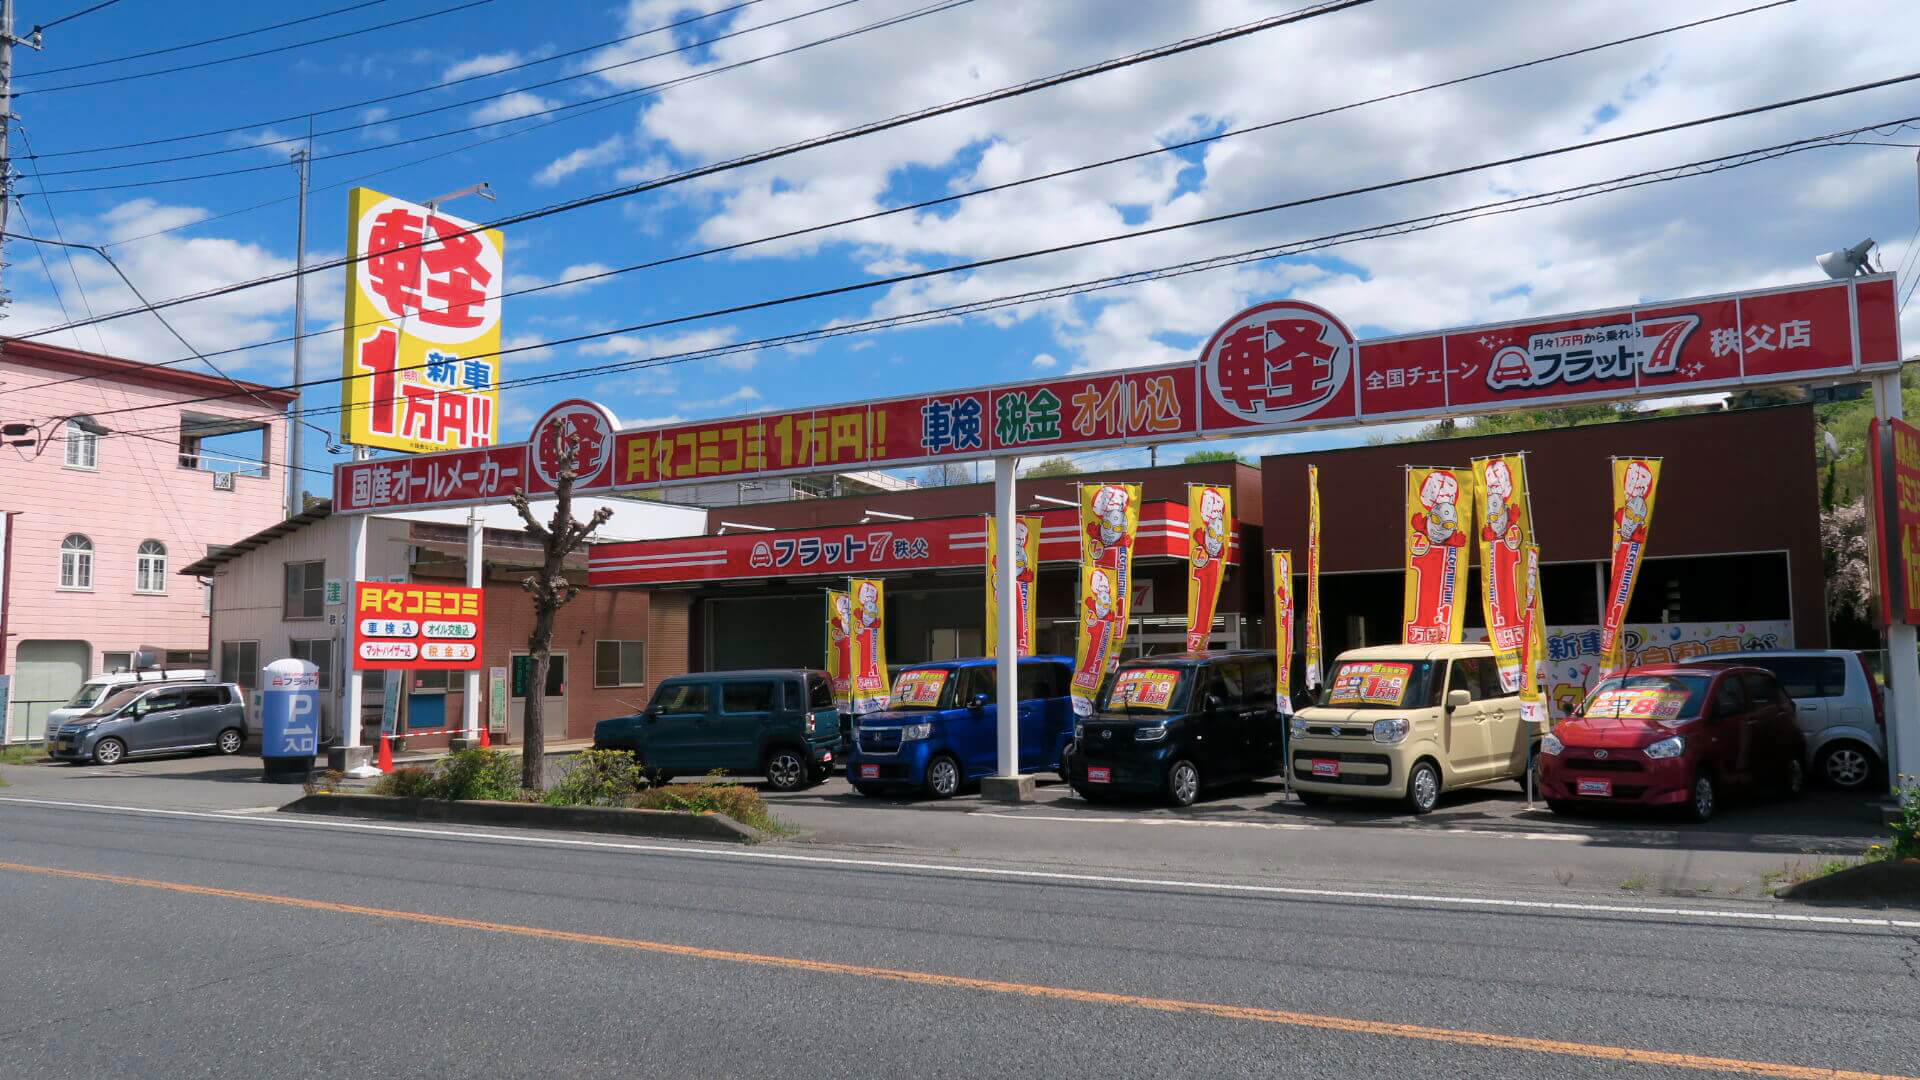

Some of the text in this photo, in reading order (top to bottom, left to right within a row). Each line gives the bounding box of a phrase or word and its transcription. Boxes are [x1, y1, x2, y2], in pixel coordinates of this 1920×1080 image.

[368, 208, 492, 329] 軽
[1710, 319, 1811, 358] 秩父店
[427, 352, 490, 390] 新車
[1217, 318, 1339, 414] 軽
[1365, 361, 1480, 391] 全国チェーン
[921, 375, 1181, 452] 車検 税金 オイル込
[352, 455, 519, 507] 国産オールメーカー
[894, 538, 929, 560] 秩父
[360, 587, 478, 617] 月々コミコミ
[367, 621, 413, 636] 車検込
[428, 645, 470, 658] 税金込
[289, 695, 313, 722] P
[284, 738, 313, 752] 入口
